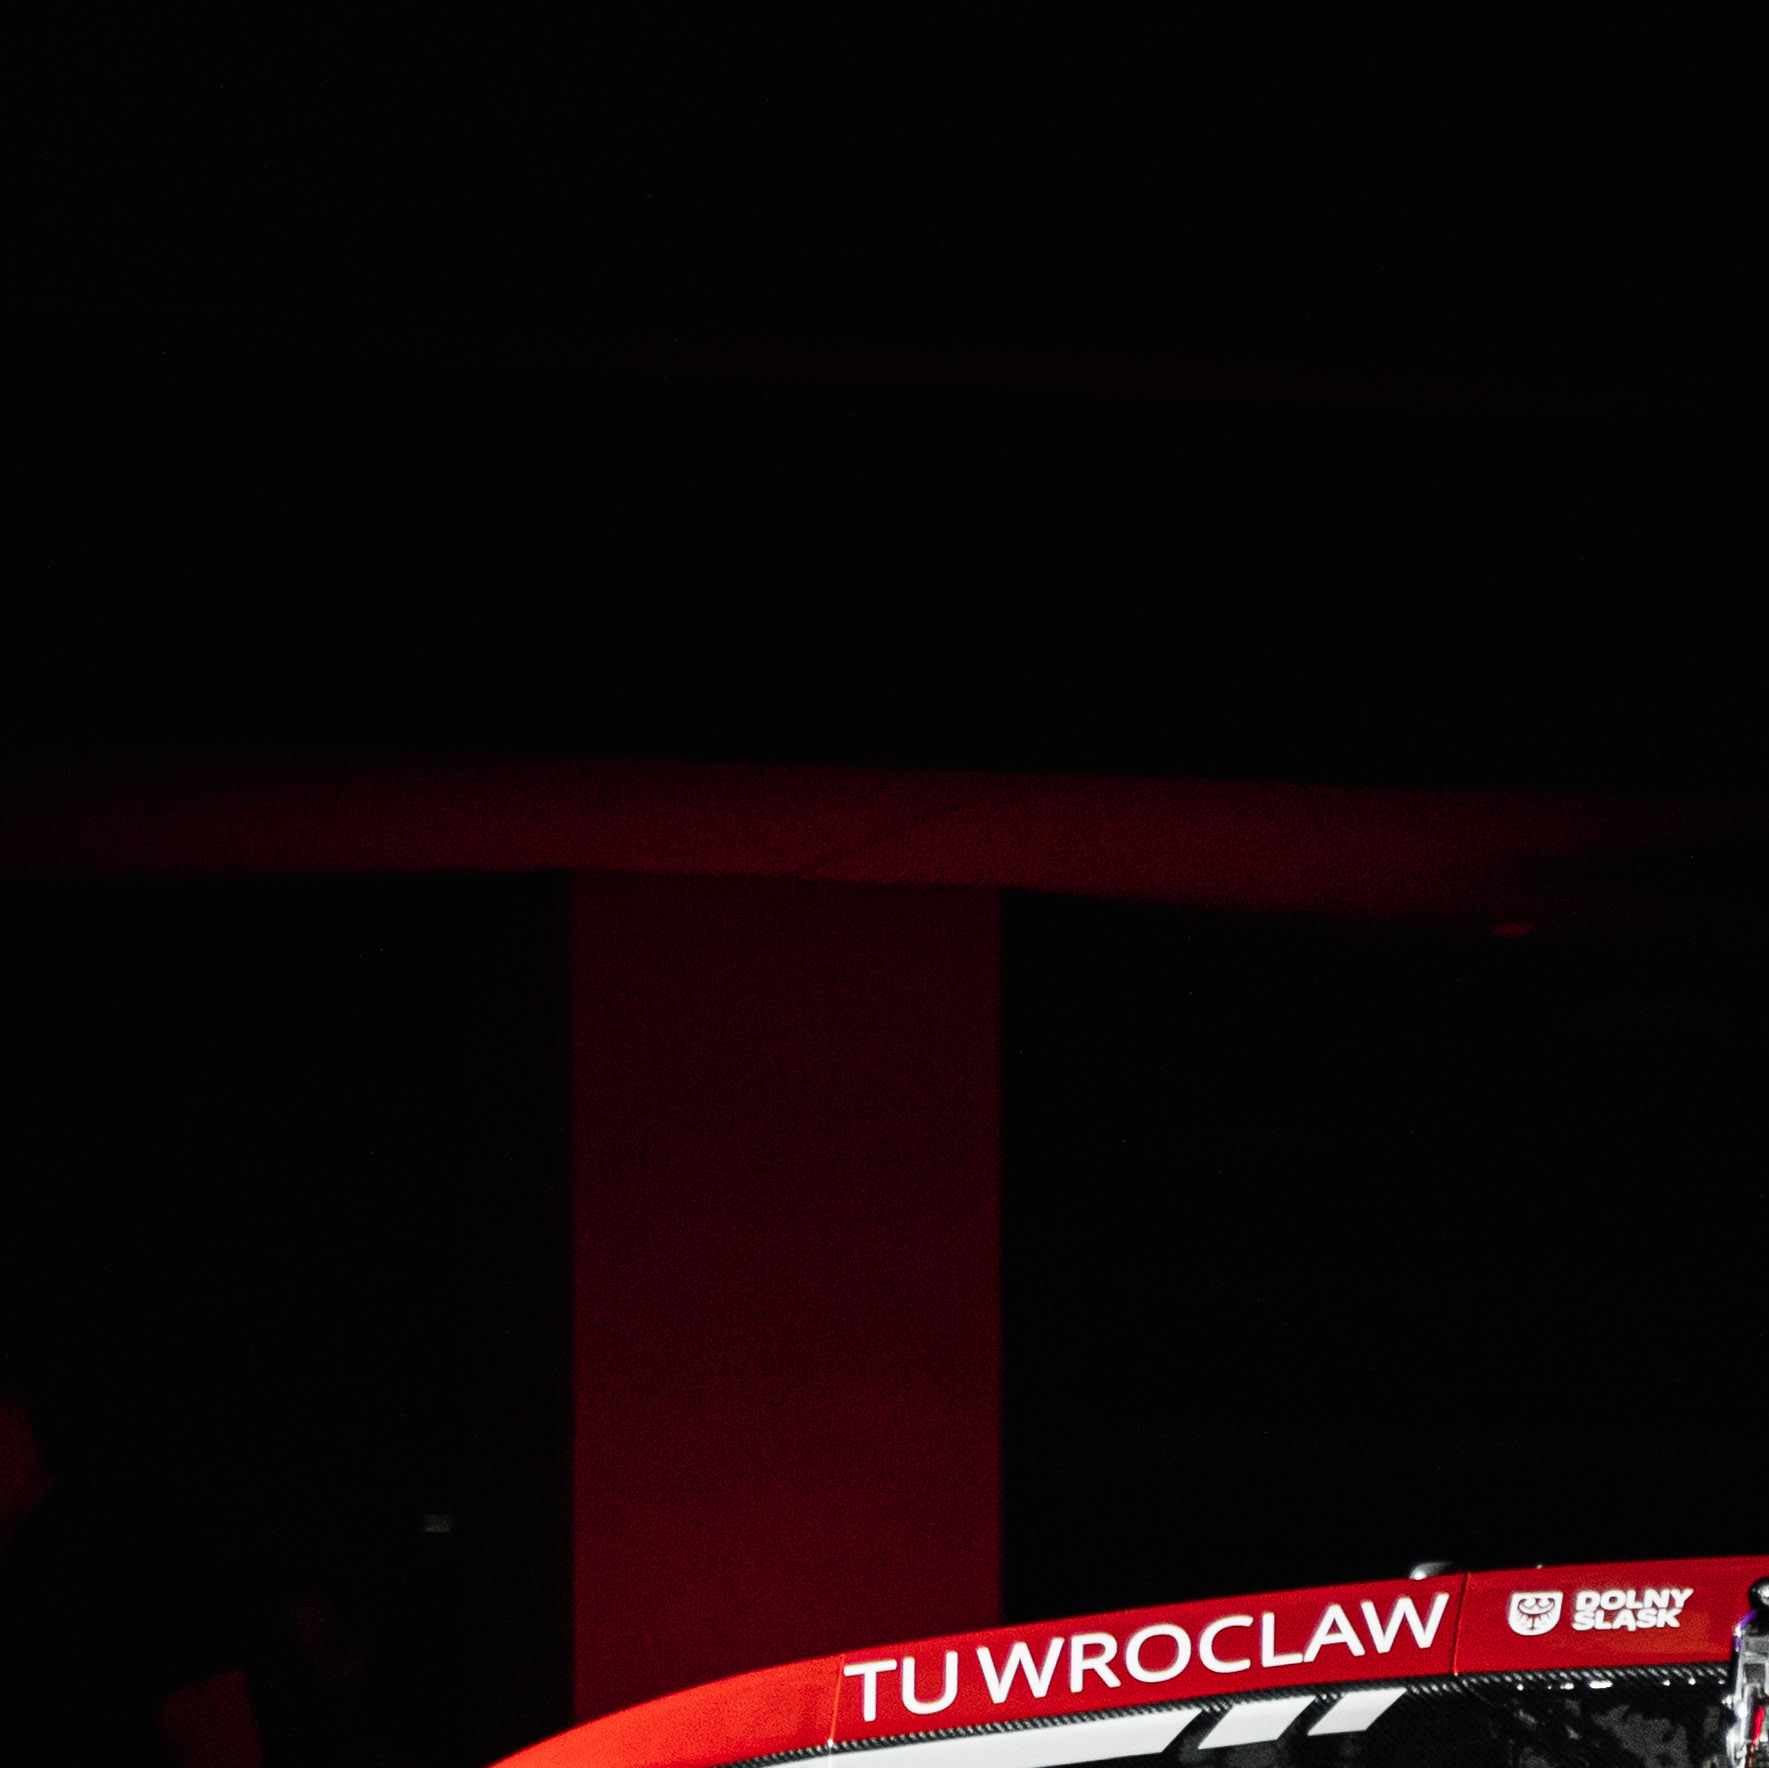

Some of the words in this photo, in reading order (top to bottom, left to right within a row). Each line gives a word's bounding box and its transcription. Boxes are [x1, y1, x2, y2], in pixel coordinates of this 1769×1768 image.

[1575, 1587, 1695, 1612] DOLNY
[843, 1649, 959, 1723] TU
[975, 1592, 1450, 1706] WROCLAW
